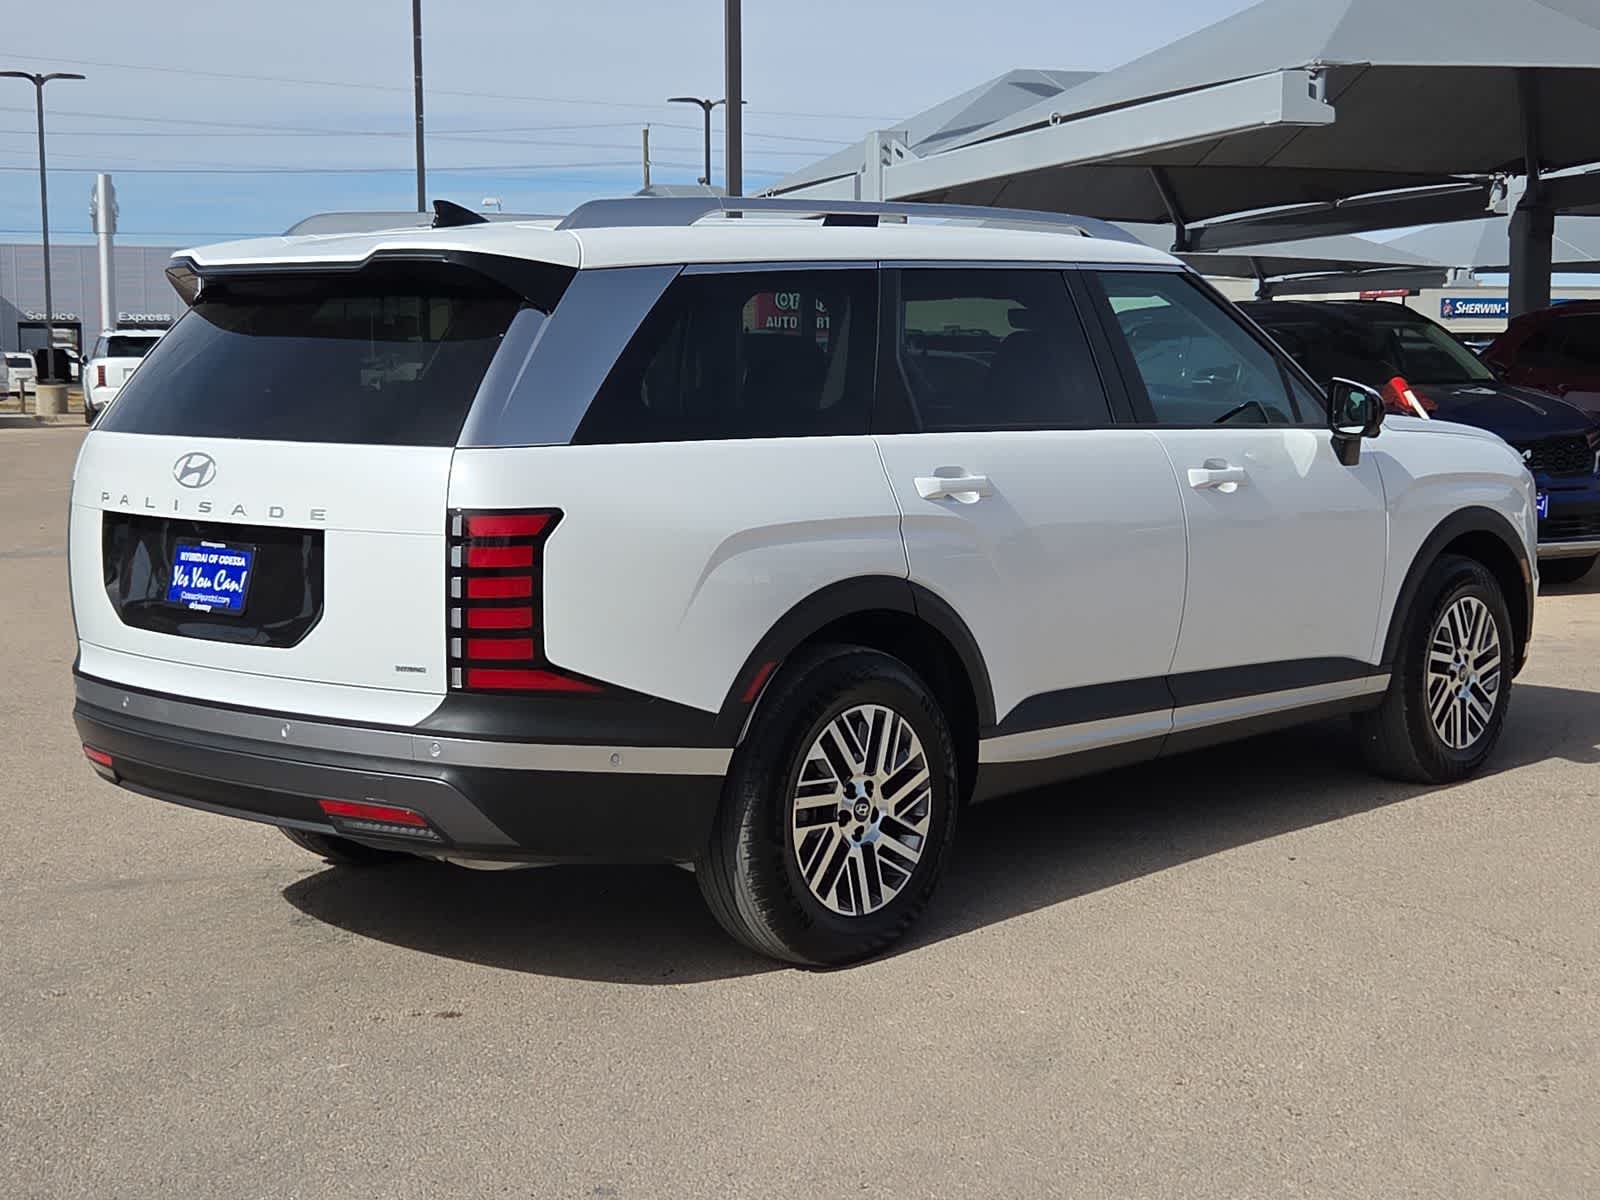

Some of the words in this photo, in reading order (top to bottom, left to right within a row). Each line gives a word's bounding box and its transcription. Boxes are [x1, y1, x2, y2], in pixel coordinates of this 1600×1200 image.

[118, 311, 171, 323] Express
[766, 316, 798, 329] AUTO
[102, 492, 327, 521] PALISADE
[172, 565, 189, 587] Yes
[191, 566, 212, 588] You
[213, 569, 248, 593] Can!
